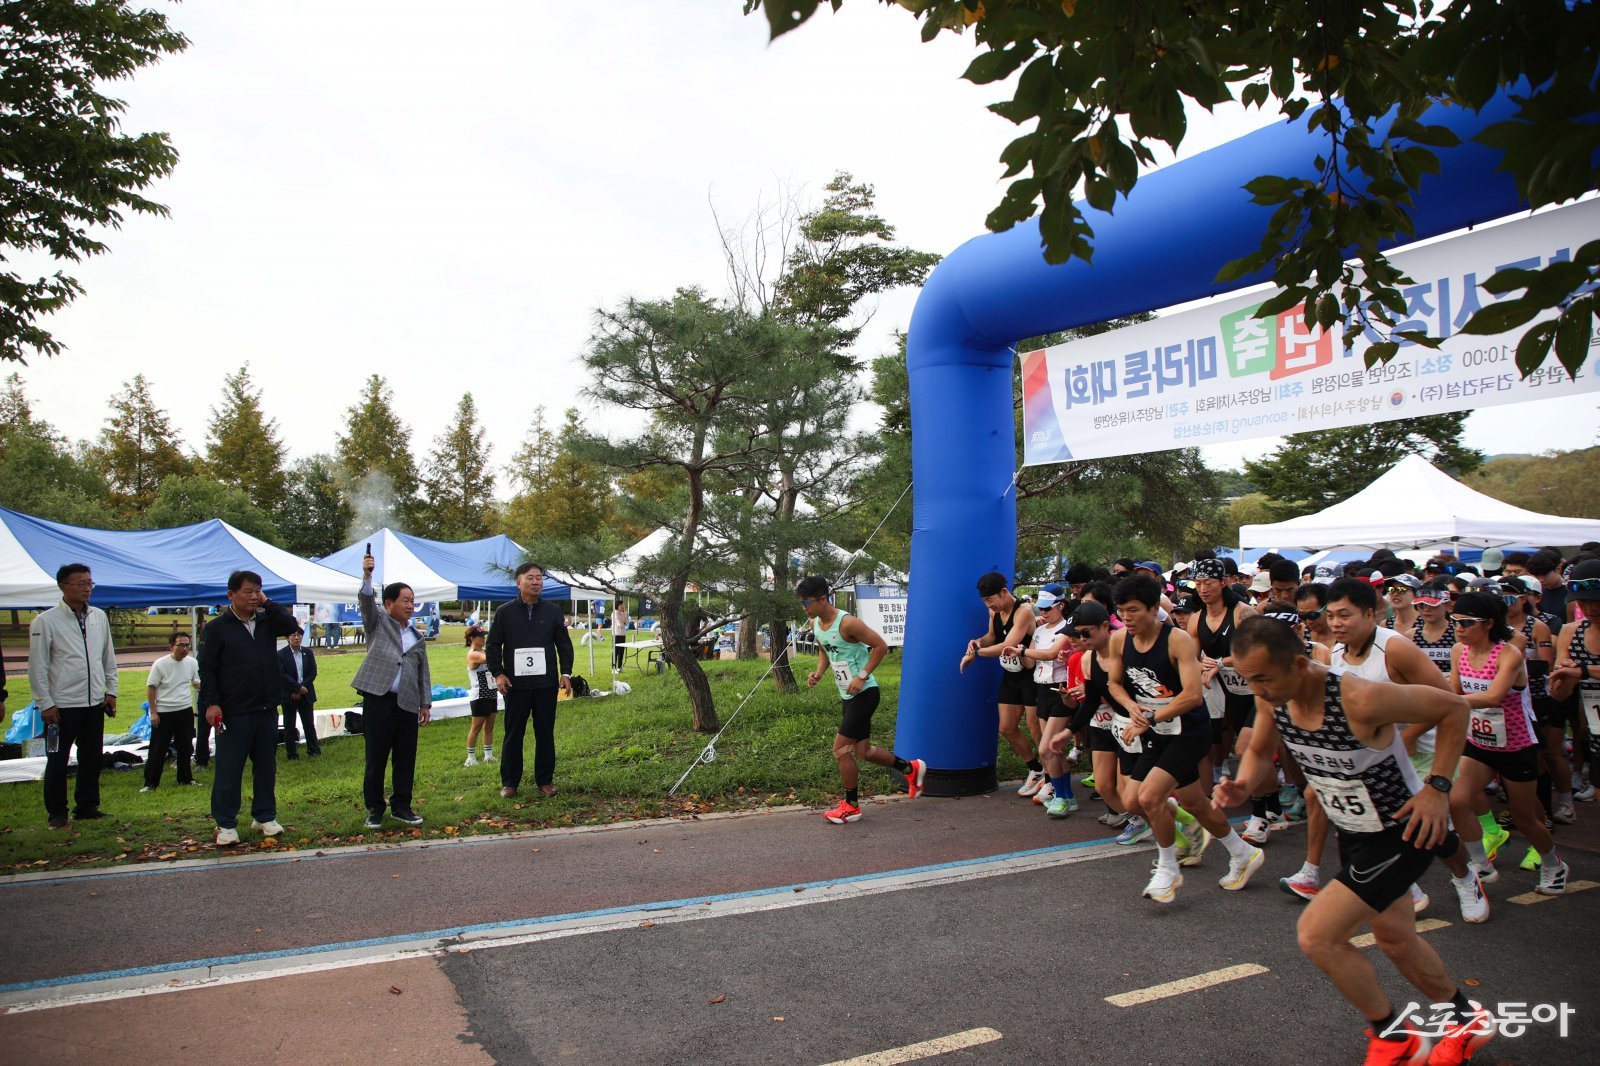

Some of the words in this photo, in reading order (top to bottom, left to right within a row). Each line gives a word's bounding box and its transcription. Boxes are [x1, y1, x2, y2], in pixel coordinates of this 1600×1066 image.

[526, 656, 534, 668] 3
[1473, 682, 1488, 692] 유러
[1471, 717, 1493, 735] 86
[1312, 753, 1356, 771] 유러닝
